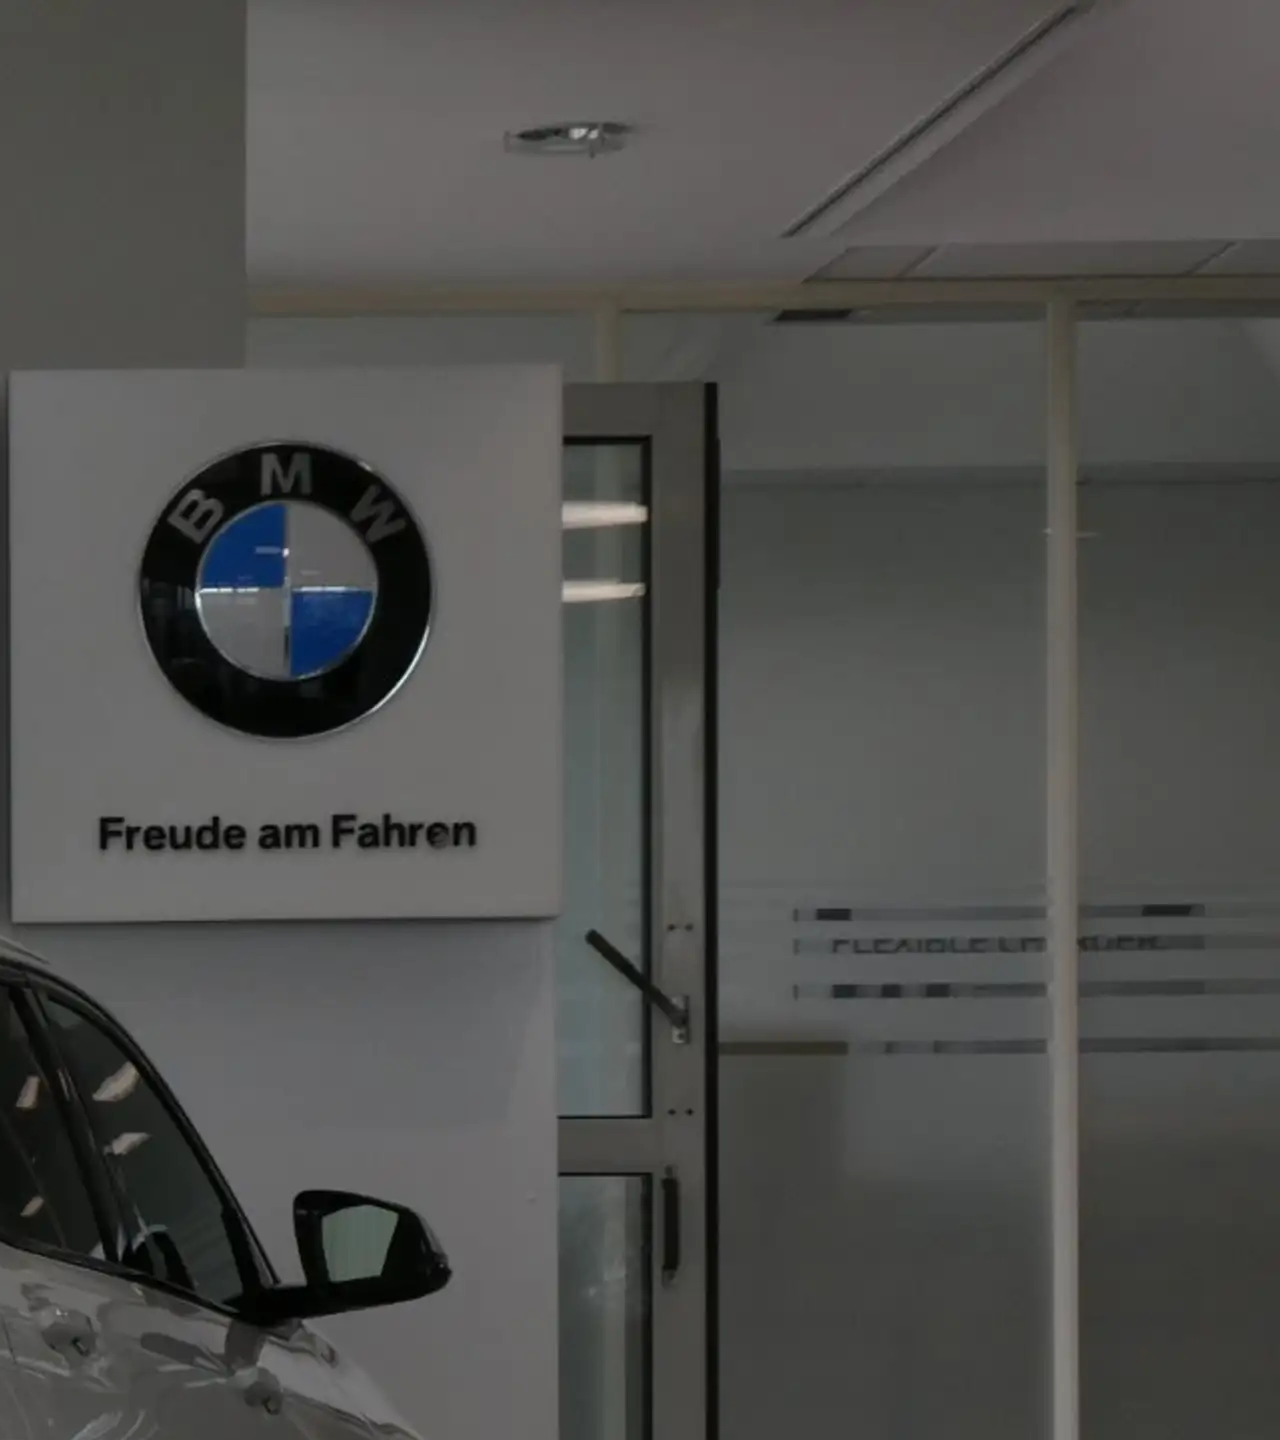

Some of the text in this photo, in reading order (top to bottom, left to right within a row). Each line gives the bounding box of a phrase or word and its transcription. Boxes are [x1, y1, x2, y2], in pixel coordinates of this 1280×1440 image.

[167, 452, 406, 545] BMW
[98, 813, 478, 851] Freude am Fahren
